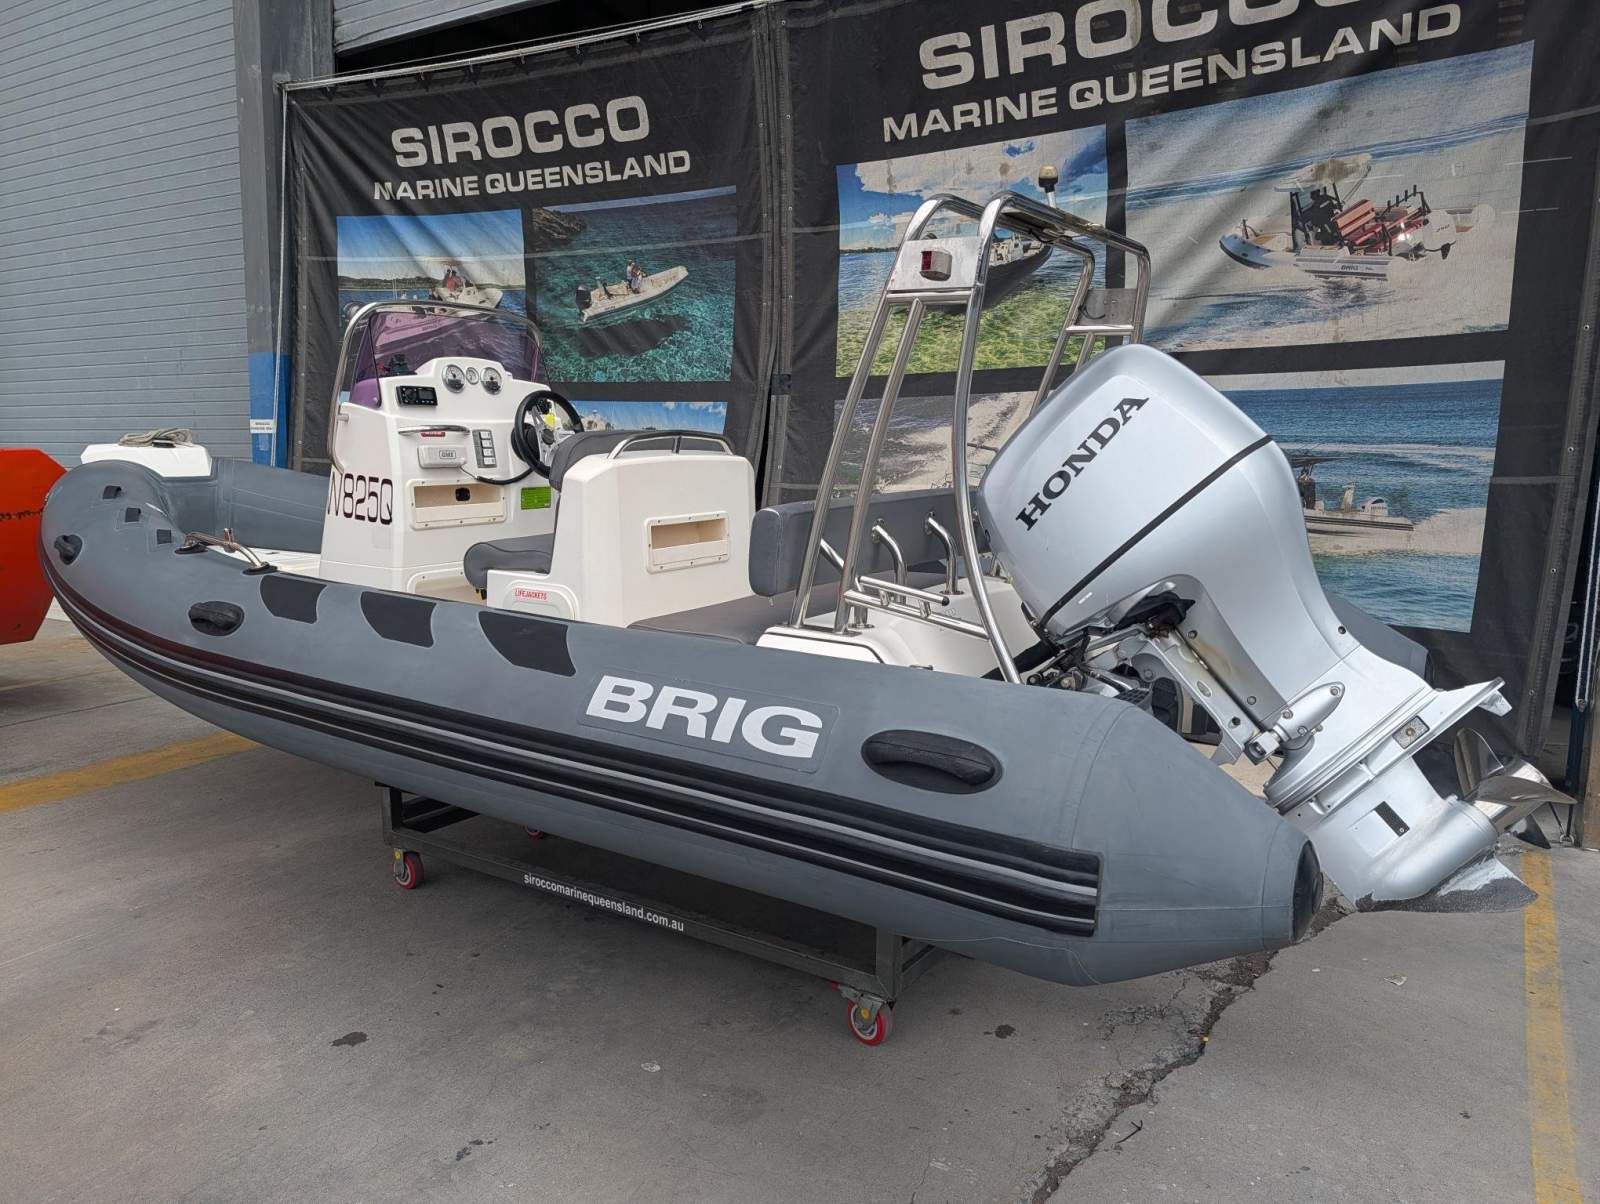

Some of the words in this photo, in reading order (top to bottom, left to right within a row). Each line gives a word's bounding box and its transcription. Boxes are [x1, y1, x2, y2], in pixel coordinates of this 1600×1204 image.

[883, 86, 1058, 143] MARINE
[1069, 3, 1462, 111] QUEENSLAND
[919, 0, 1358, 90] SIROC
[391, 95, 650, 168] SIROCCO
[373, 175, 480, 201] MARINE
[485, 150, 691, 194] QUEENSLAND
[1015, 397, 1150, 531] HONDA
[585, 675, 823, 759] BRIG
[523, 872, 684, 931] siroccomarinequeensland.com.au
